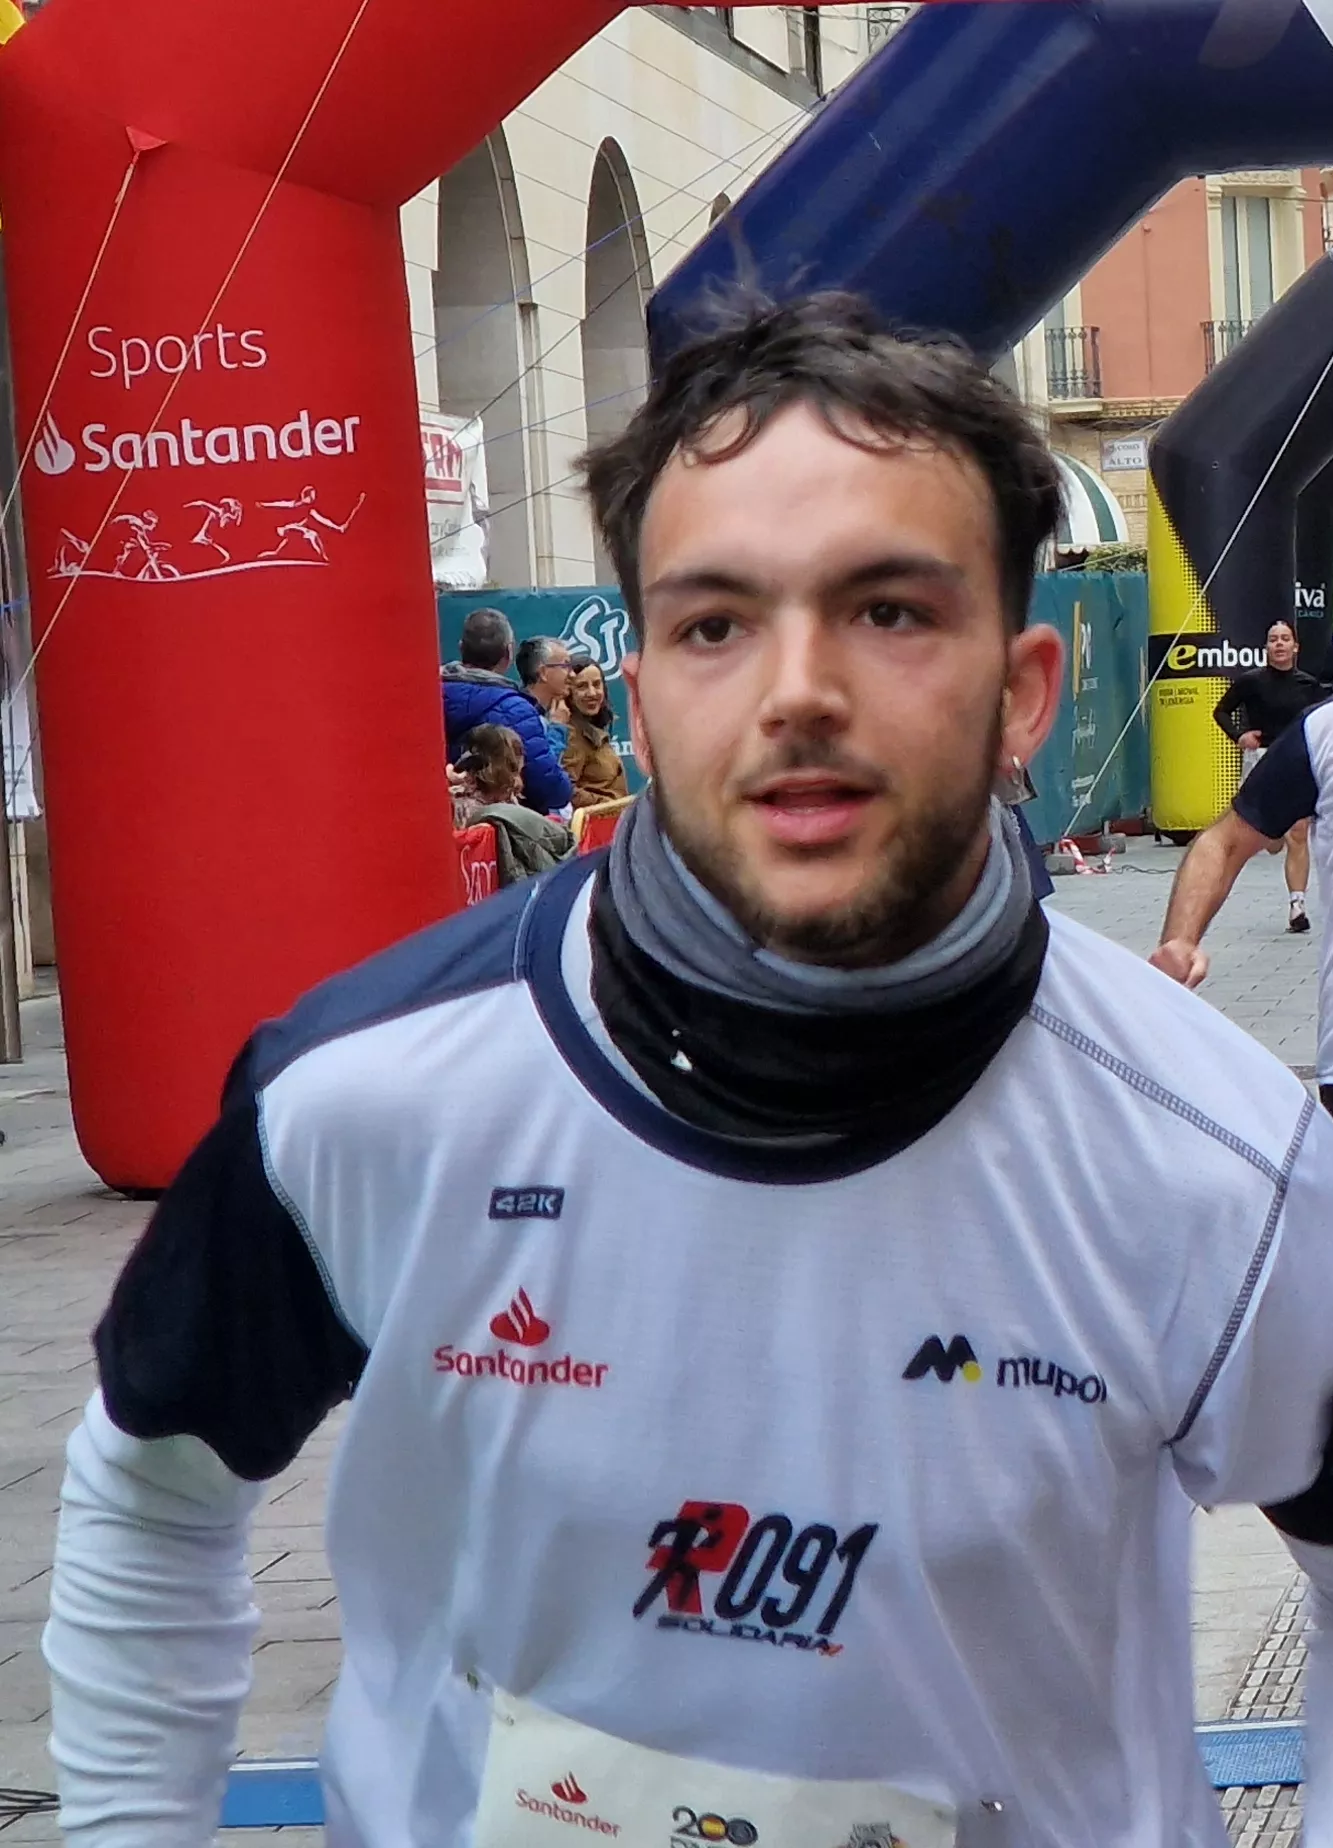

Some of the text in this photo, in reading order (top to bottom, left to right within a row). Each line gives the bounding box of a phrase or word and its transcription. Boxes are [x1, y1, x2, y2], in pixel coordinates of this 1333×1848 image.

[88, 323, 268, 390] Sports
[82, 409, 361, 473] Santander
[1109, 456, 1142, 466] ALTO
[1167, 639, 1268, 671] embou
[495, 1191, 556, 1216] 42K
[433, 1344, 609, 1388] Santander
[996, 1354, 1109, 1404] mupol
[655, 1613, 834, 1654] SOLIDARIA
[514, 1787, 623, 1840] Santander
